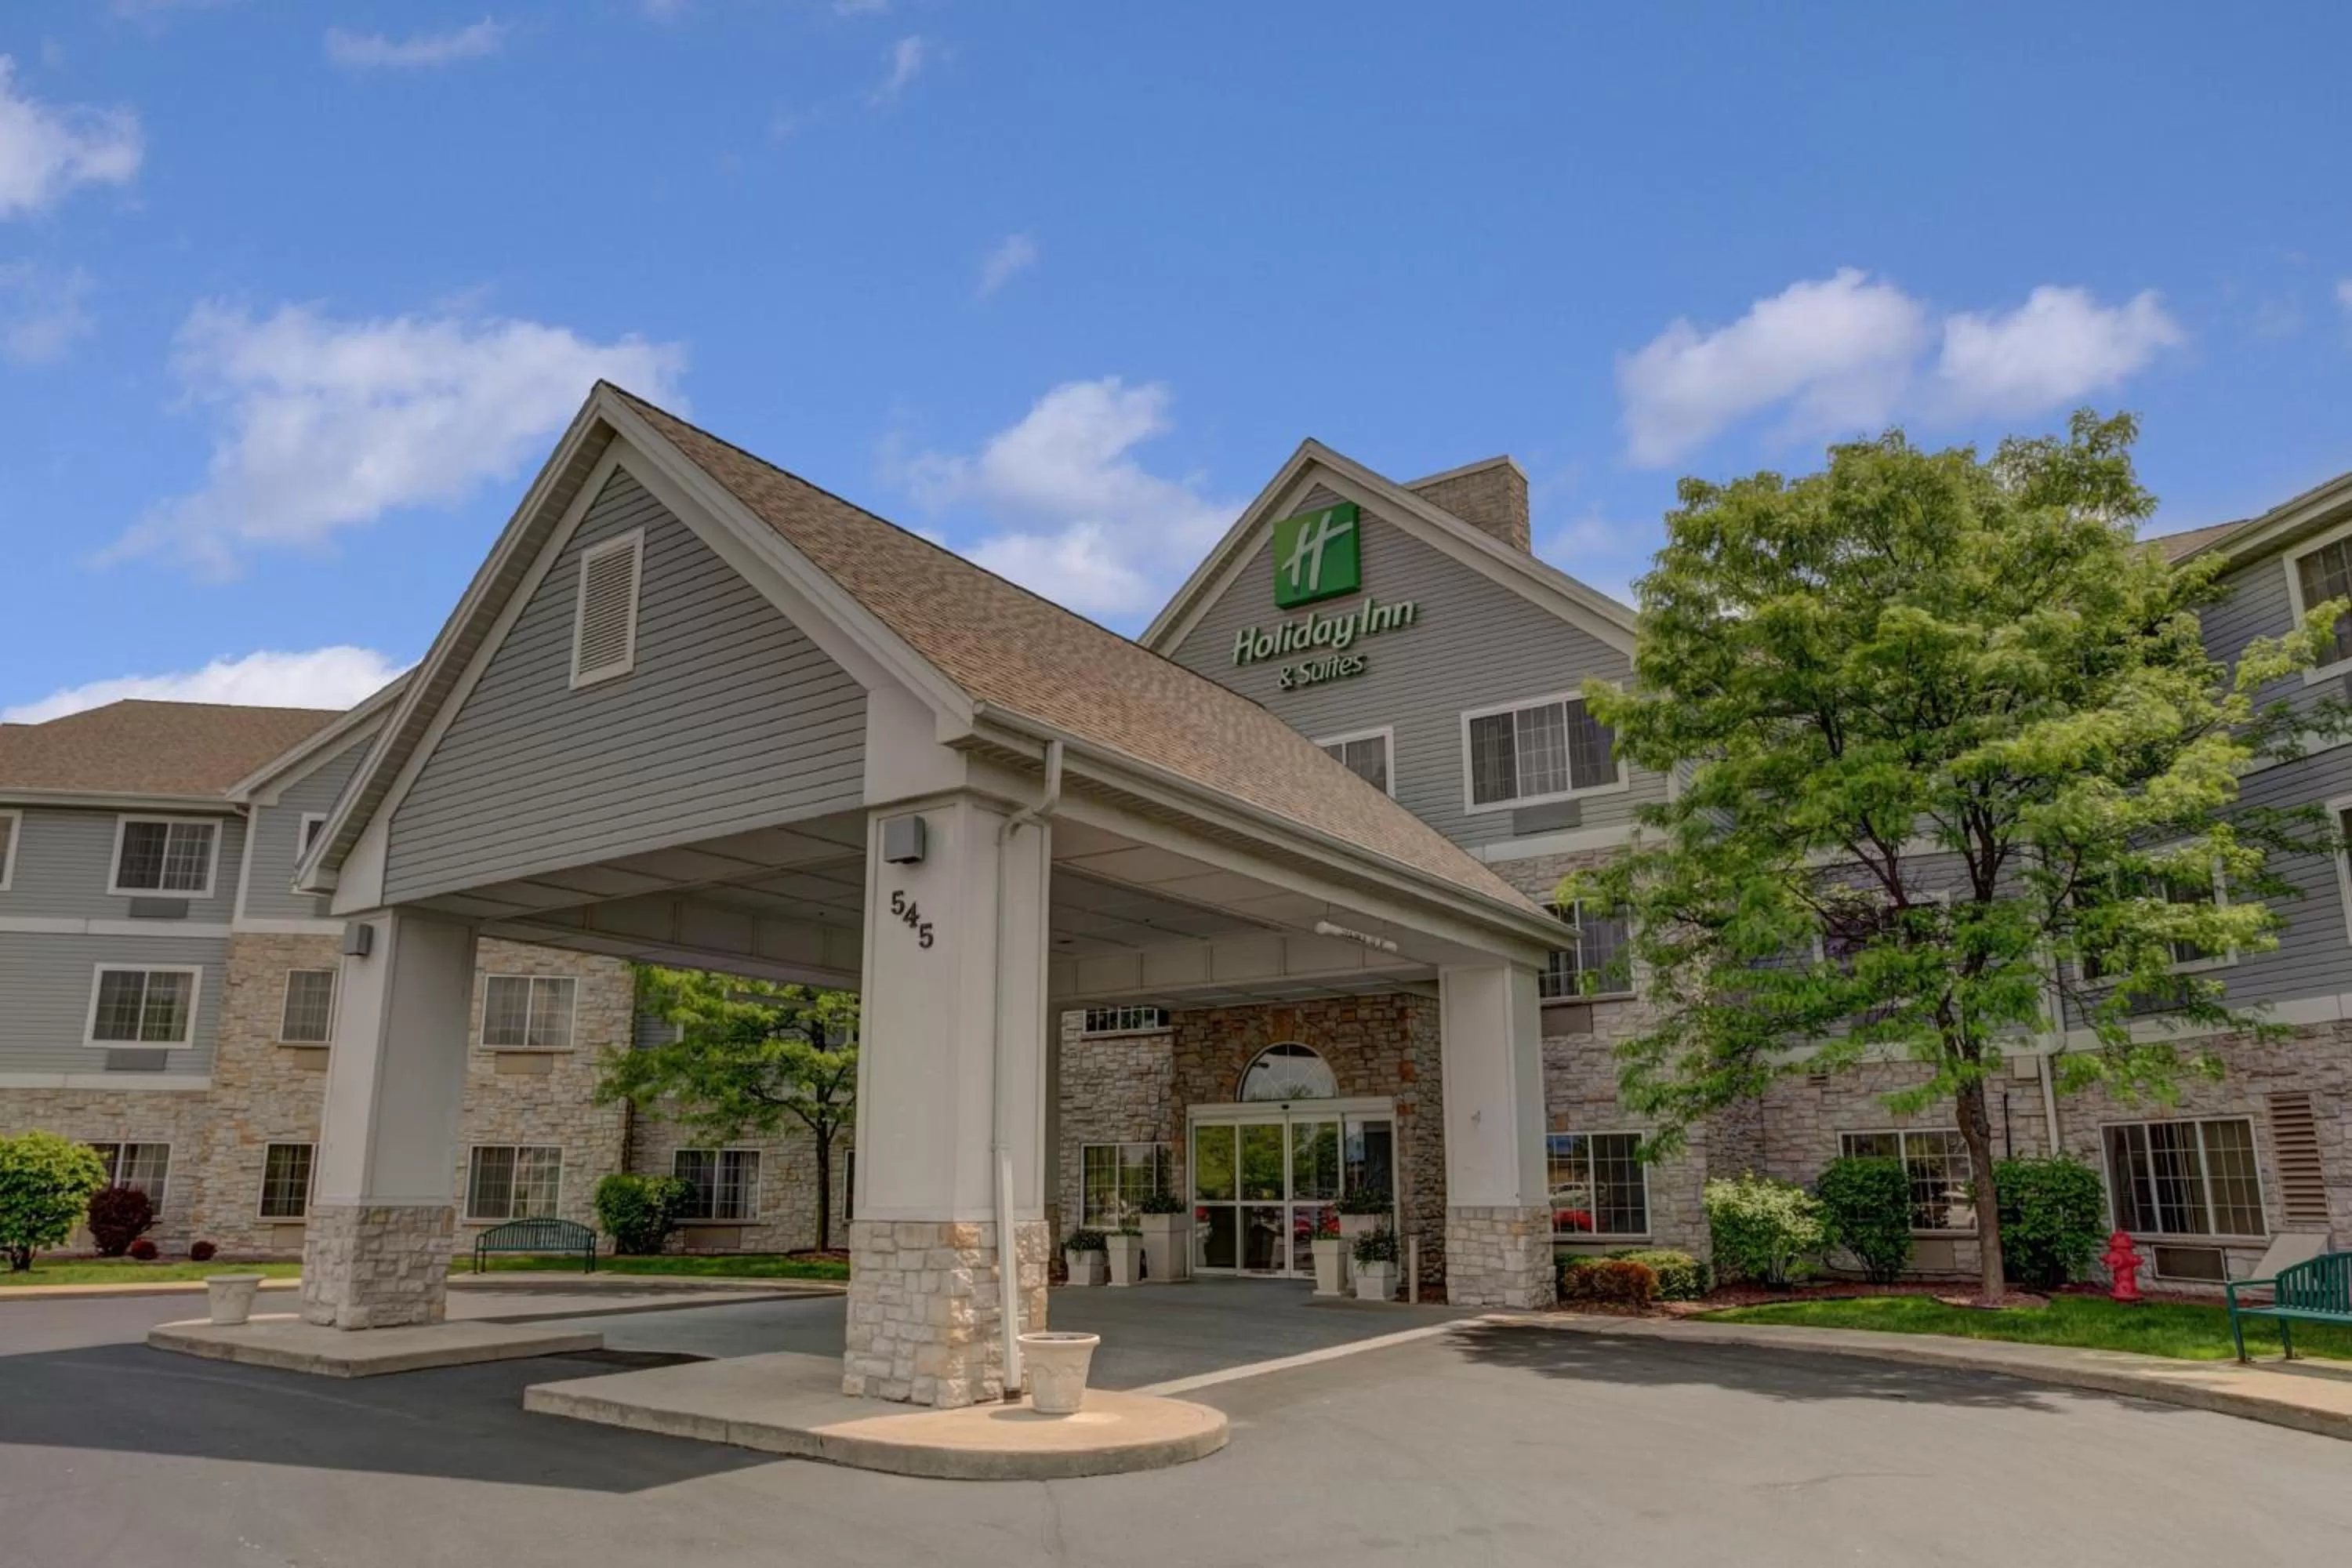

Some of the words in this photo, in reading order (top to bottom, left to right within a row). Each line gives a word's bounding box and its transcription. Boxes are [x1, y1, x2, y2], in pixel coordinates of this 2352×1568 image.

[1282, 510, 1354, 590] H
[1232, 612, 1357, 665] Holiday
[1360, 597, 1416, 634] Inn
[1278, 666, 1294, 689] &
[1297, 655, 1366, 685] Suites
[891, 890, 935, 949] 545
